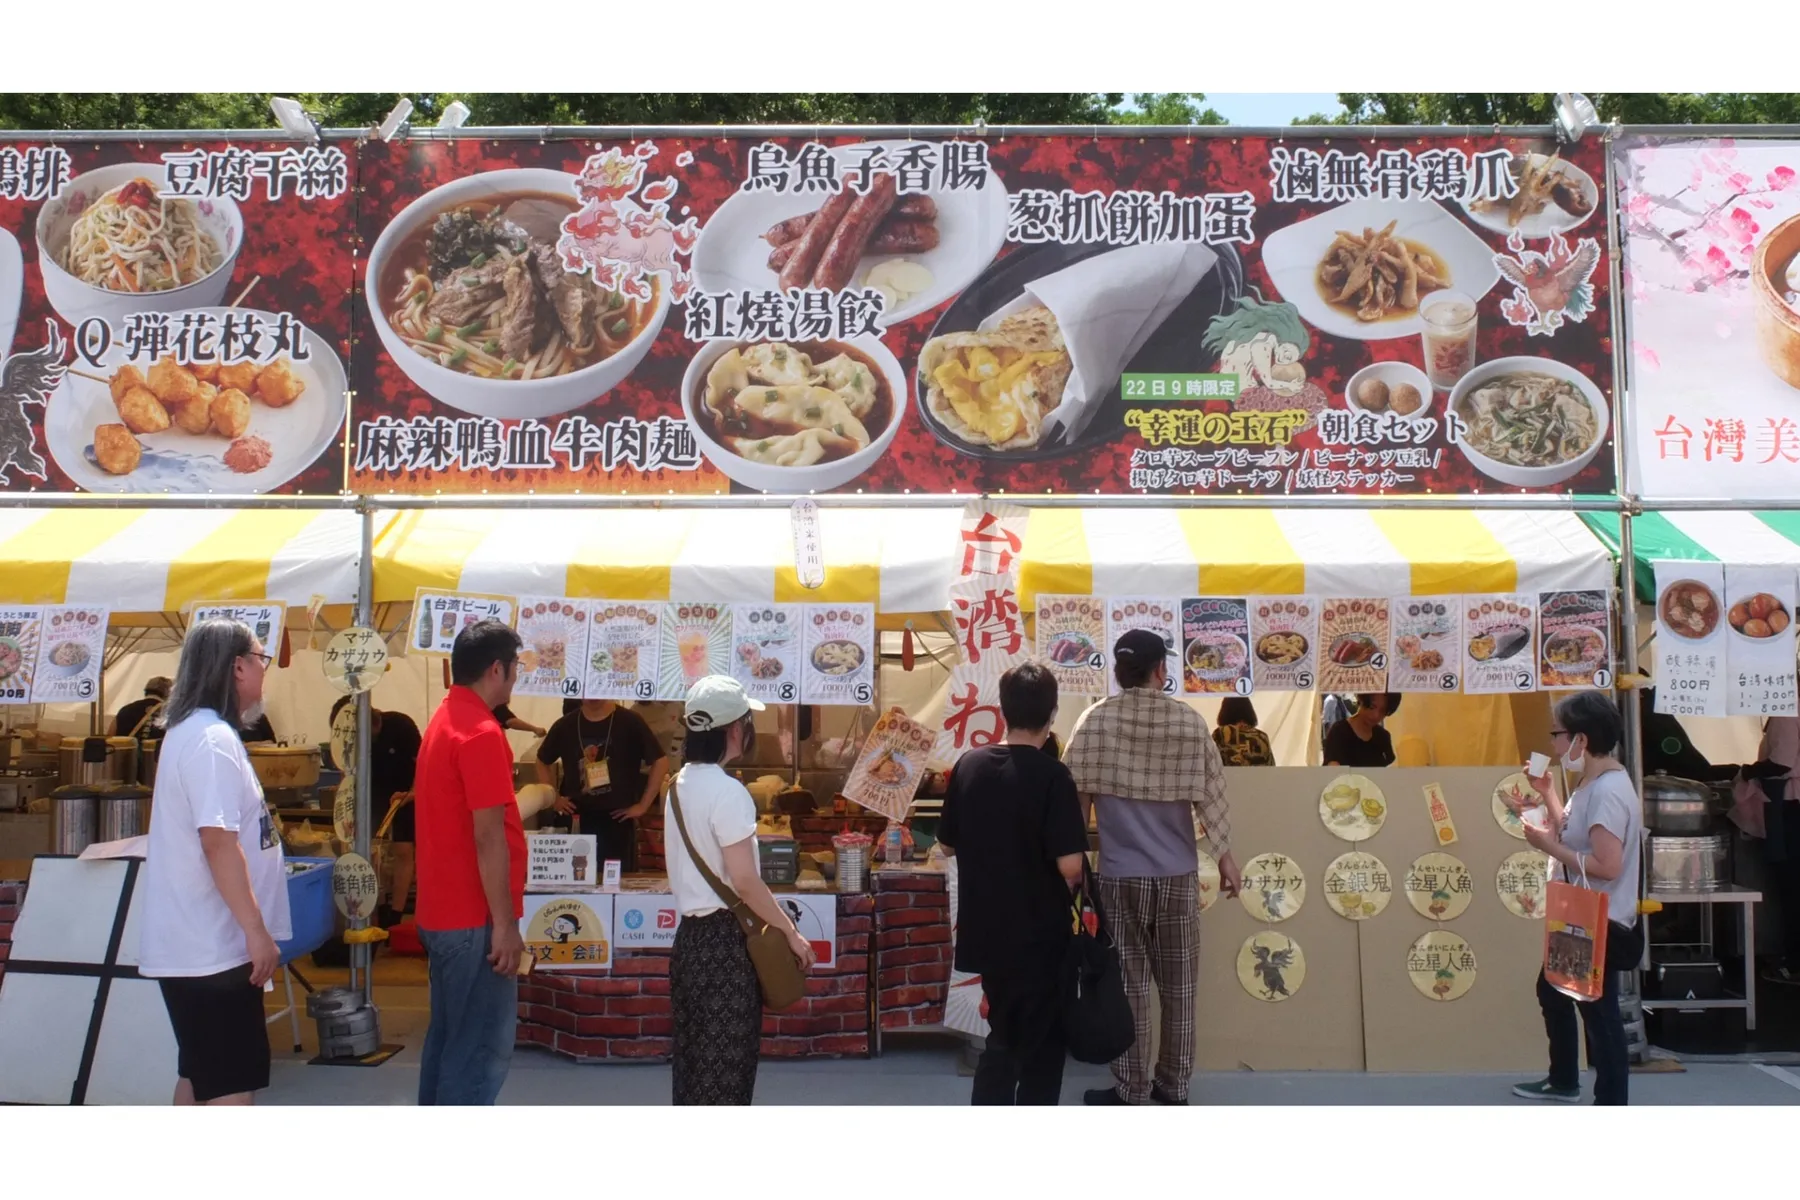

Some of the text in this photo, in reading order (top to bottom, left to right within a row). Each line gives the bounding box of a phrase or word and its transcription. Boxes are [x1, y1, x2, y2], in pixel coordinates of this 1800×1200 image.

[160, 149, 345, 199] 豆腐干絲
[77, 317, 111, 368] Q
[1320, 412, 1467, 443] 朝食セット
[433, 597, 501, 615] 台湾ビール
[344, 632, 374, 645] マザ
[327, 648, 386, 663] カザカウ
[1670, 678, 1711, 691] 800円
[1256, 857, 1287, 871] マザ
[1502, 860, 1548, 870] けいかくせ
[1241, 875, 1303, 892] カザカウ
[1325, 872, 1391, 895] 金銀鬼
[1405, 874, 1473, 893] 金星人魚
[652, 933, 676, 941] PayPa
[1408, 953, 1476, 972] 金星人魚
